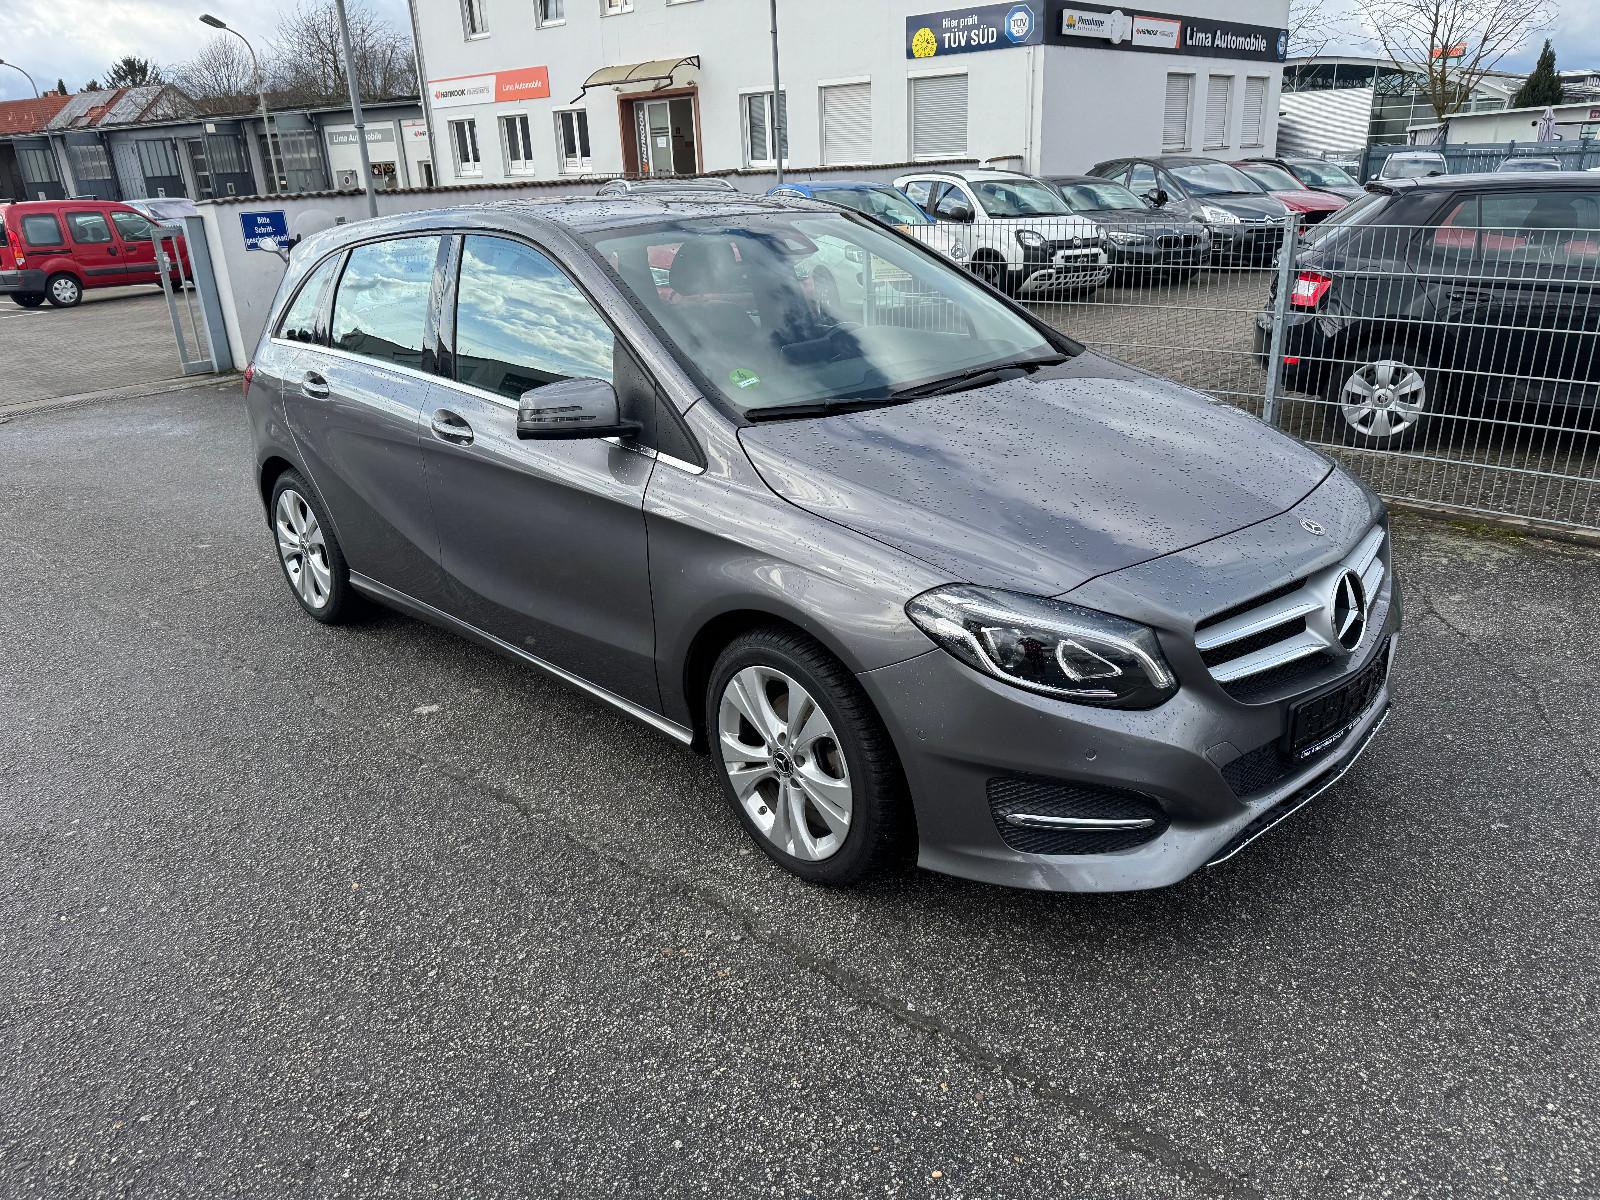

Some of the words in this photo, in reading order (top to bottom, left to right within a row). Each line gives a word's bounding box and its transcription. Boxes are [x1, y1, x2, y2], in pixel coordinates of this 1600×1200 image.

[942, 18, 958, 29] Hier
[960, 14, 978, 29] prüft
[942, 28, 968, 49] TÜV
[970, 24, 997, 46] SÜD
[1186, 26, 1212, 47] Lima
[1213, 29, 1267, 52] Automobile
[502, 82, 515, 92] Lima
[514, 79, 543, 91] Automobile
[333, 134, 347, 143] Lima
[256, 216, 270, 224] Bitte
[254, 225, 276, 234] Schritt-
